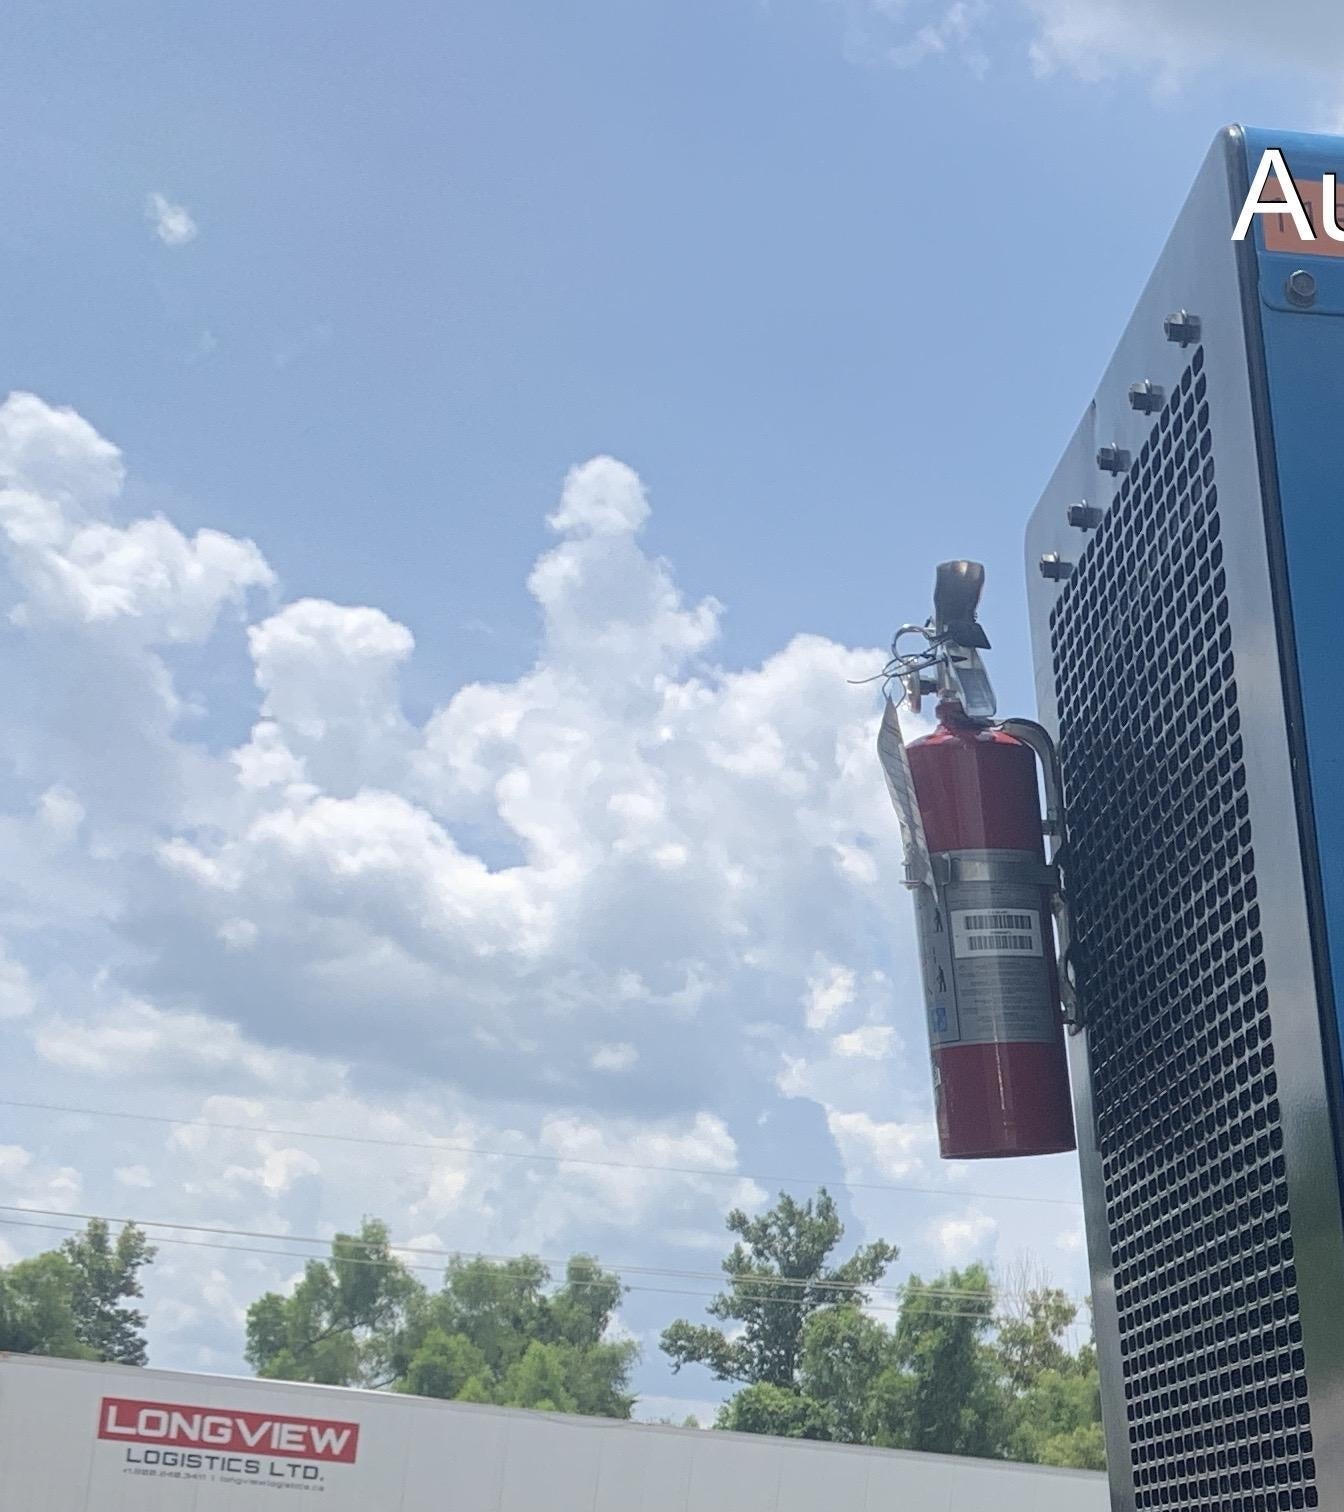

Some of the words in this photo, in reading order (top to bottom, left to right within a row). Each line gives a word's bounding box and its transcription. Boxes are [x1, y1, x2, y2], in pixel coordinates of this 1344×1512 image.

[105, 1404, 352, 1457] LONGVIEW
[125, 1447, 261, 1475] LOGISTICS
[269, 1461, 325, 1482] LTD.
